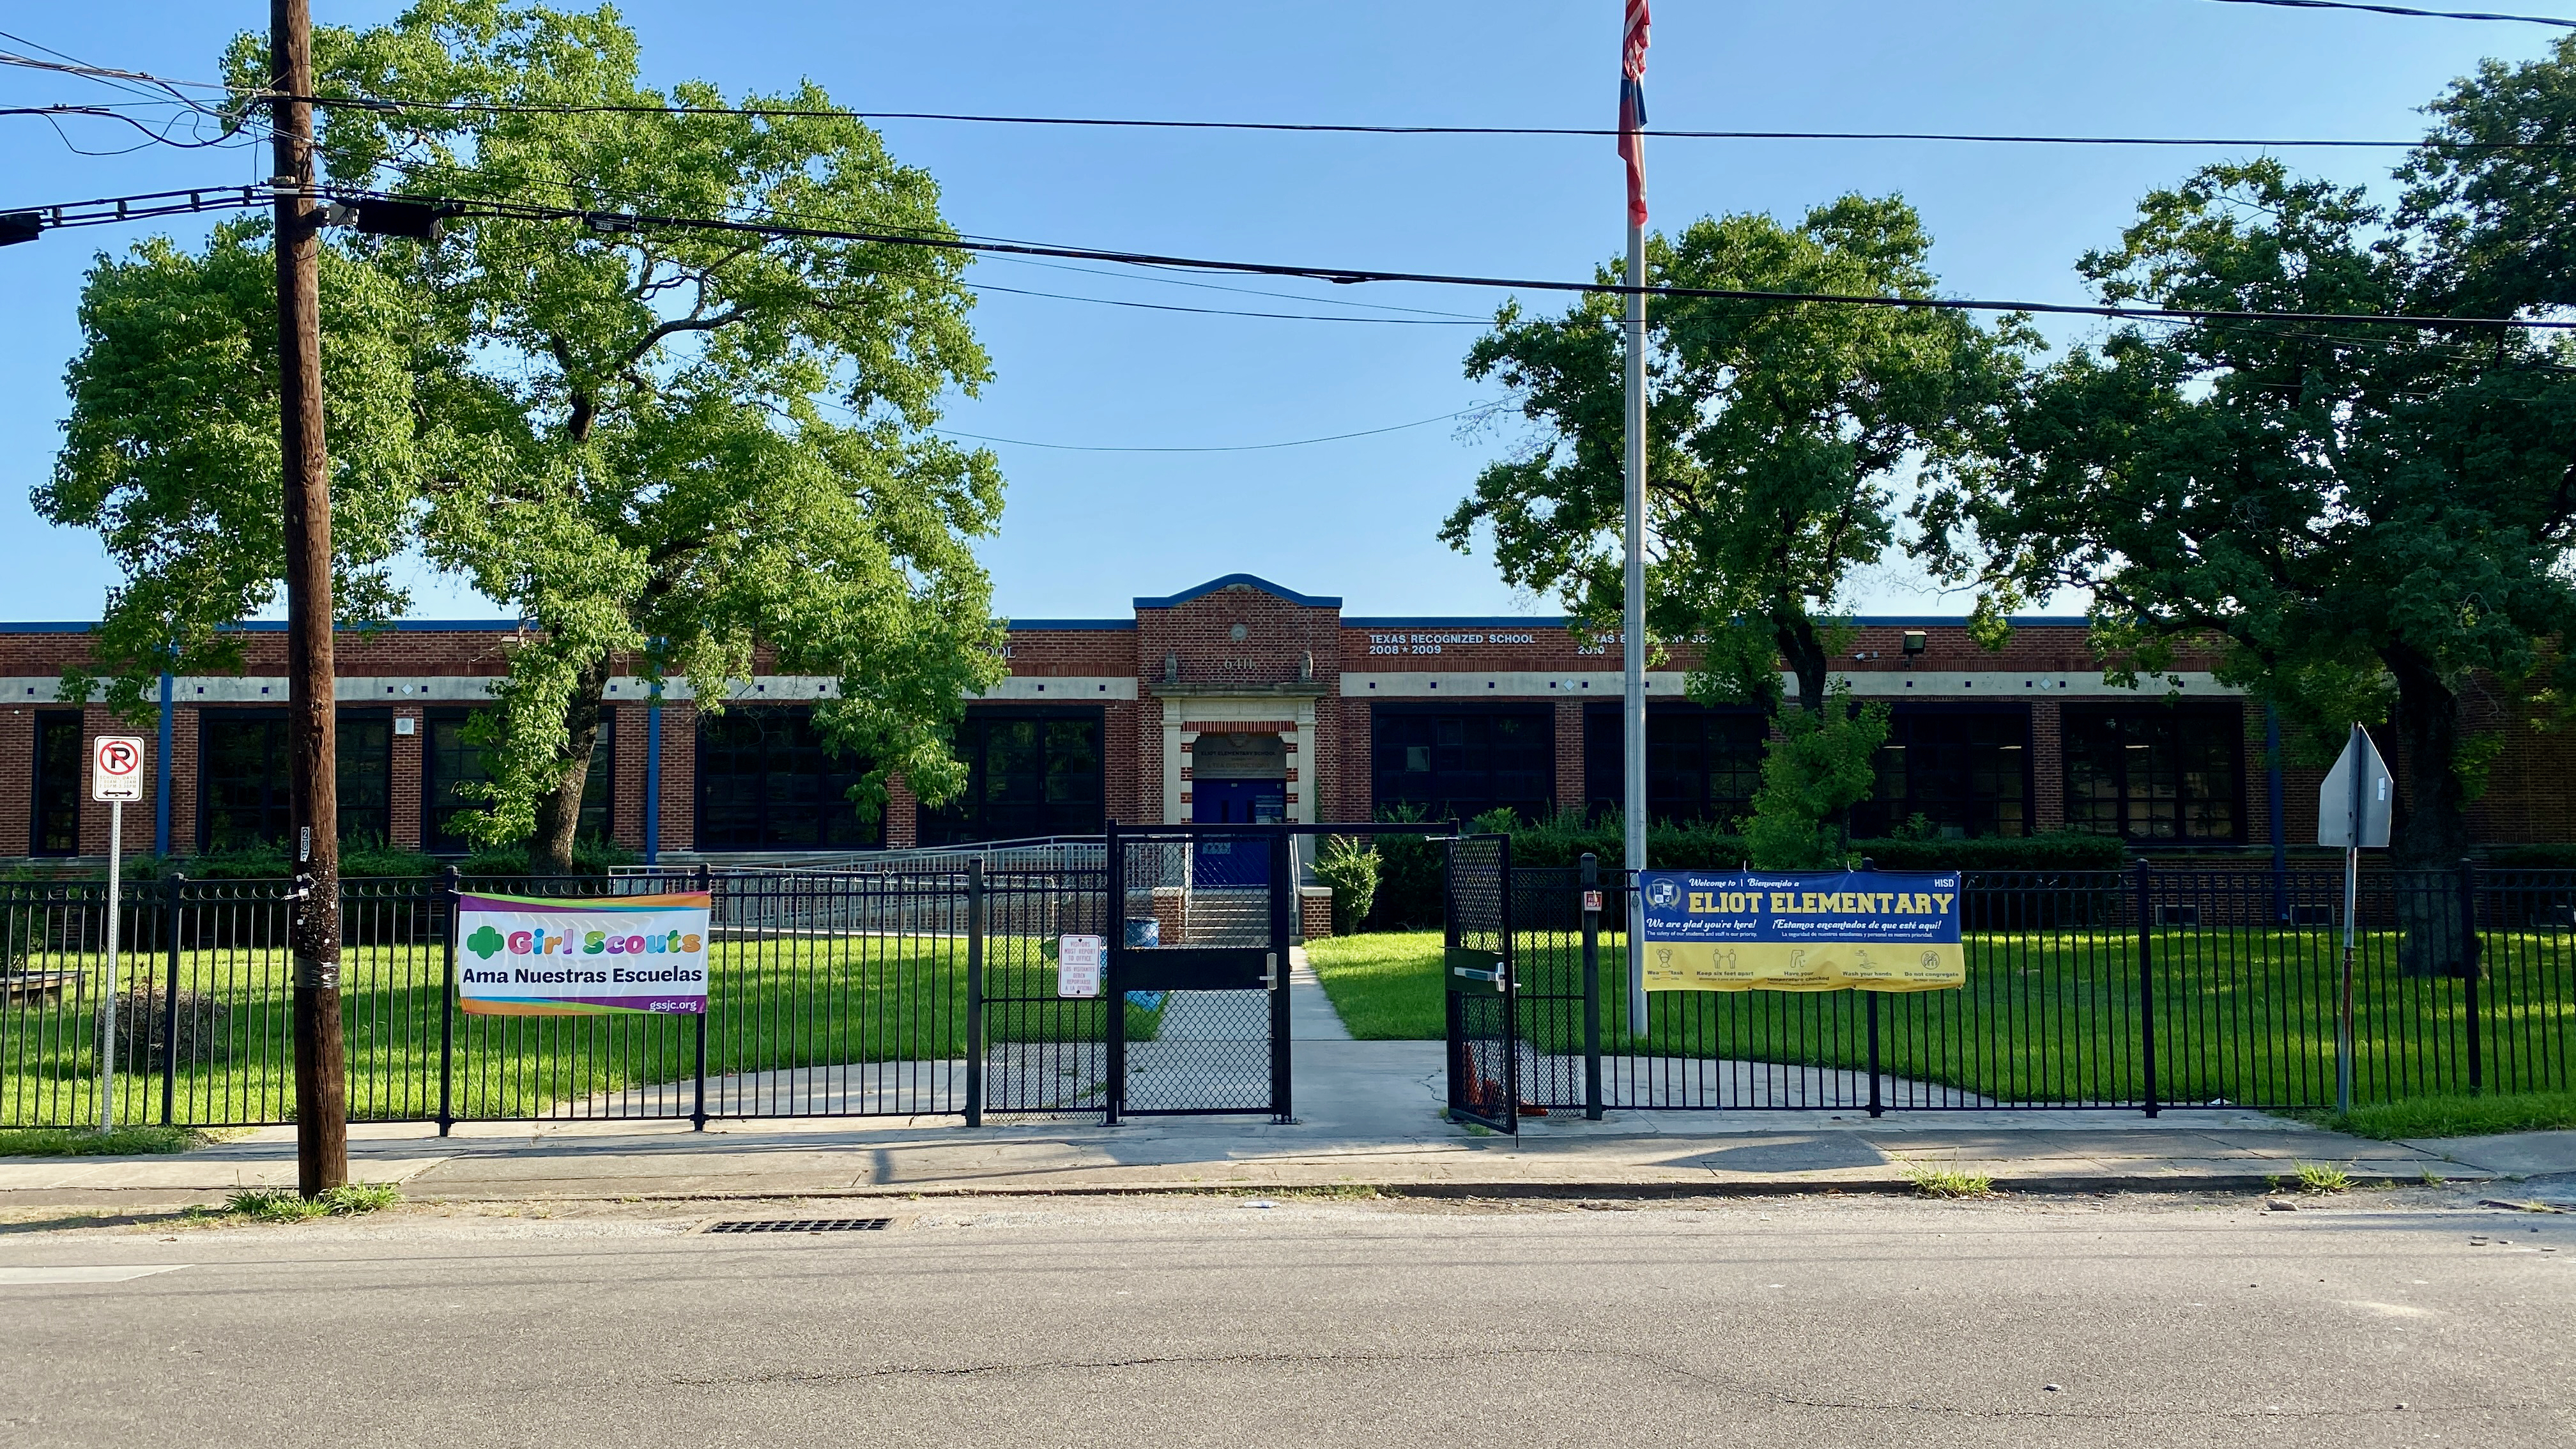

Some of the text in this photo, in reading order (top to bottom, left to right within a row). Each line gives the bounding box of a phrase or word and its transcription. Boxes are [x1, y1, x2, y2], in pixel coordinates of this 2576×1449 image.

[1369, 634, 1535, 644] TEXAS RECOGNIZED SCHOOL
[1369, 645, 1442, 655] 2008 2009
[1224, 658, 1252, 670] 6411
[1689, 878, 1726, 888] Welcome
[1747, 878, 1792, 888] Bienvenido
[1935, 879, 1954, 887] HISD
[1688, 892, 1954, 914] ELIOT ELEMENTARY
[1646, 918, 1664, 928] We
[1682, 920, 1703, 931] glad
[1733, 919, 1757, 930] here!
[1772, 919, 1814, 930] ¡Estamos
[1817, 921, 1866, 930] encantados
[1868, 921, 1878, 929] de
[1881, 923, 1897, 931] que
[508, 928, 702, 955] Girl Scouts
[463, 965, 702, 984] Ama Nuestras Escuelas
[648, 1000, 697, 1012] gssjc.org
